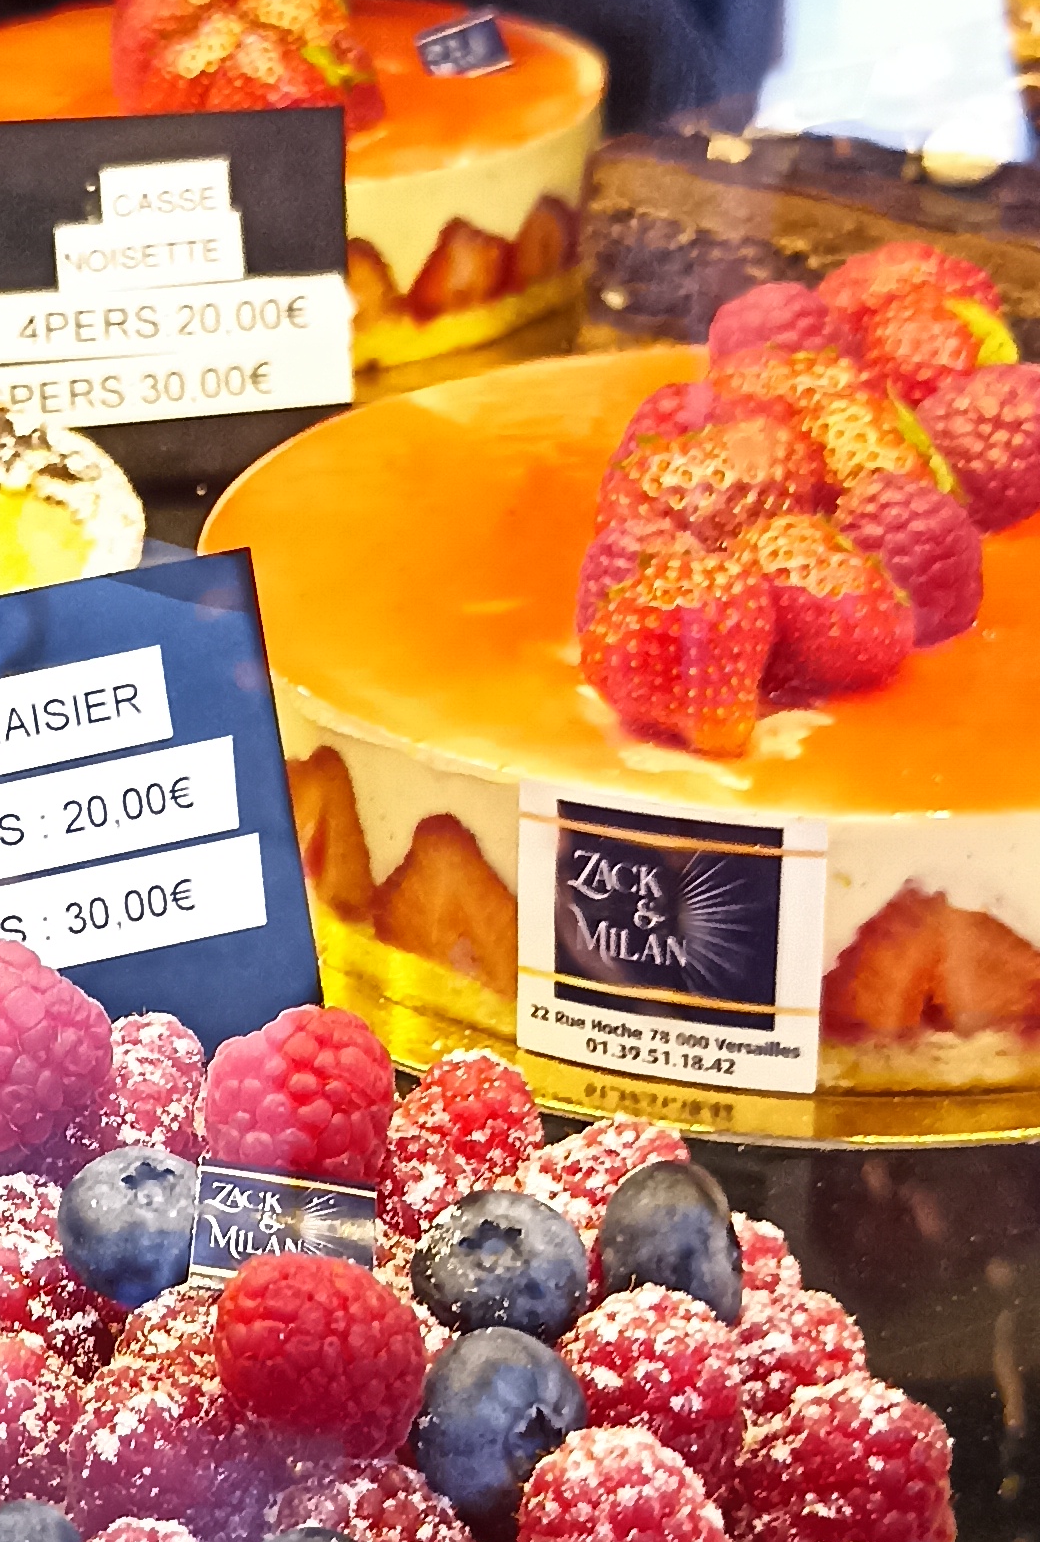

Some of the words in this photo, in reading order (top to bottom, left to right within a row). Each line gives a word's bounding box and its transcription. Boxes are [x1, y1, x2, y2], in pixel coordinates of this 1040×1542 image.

[112, 185, 218, 218] CASSE
[62, 775, 195, 835] 20,00€
[566, 849, 663, 901] ZACK
[65, 878, 197, 936] 30,00€
[633, 898, 666, 930] &
[568, 903, 688, 968] MILAN
[530, 1003, 550, 1022] 22
[554, 1010, 586, 1029] Rue
[649, 1028, 671, 1045] 78
[204, 1181, 283, 1214] ZACK
[202, 1214, 304, 1260] MILAN
[258, 1211, 286, 1234] &
